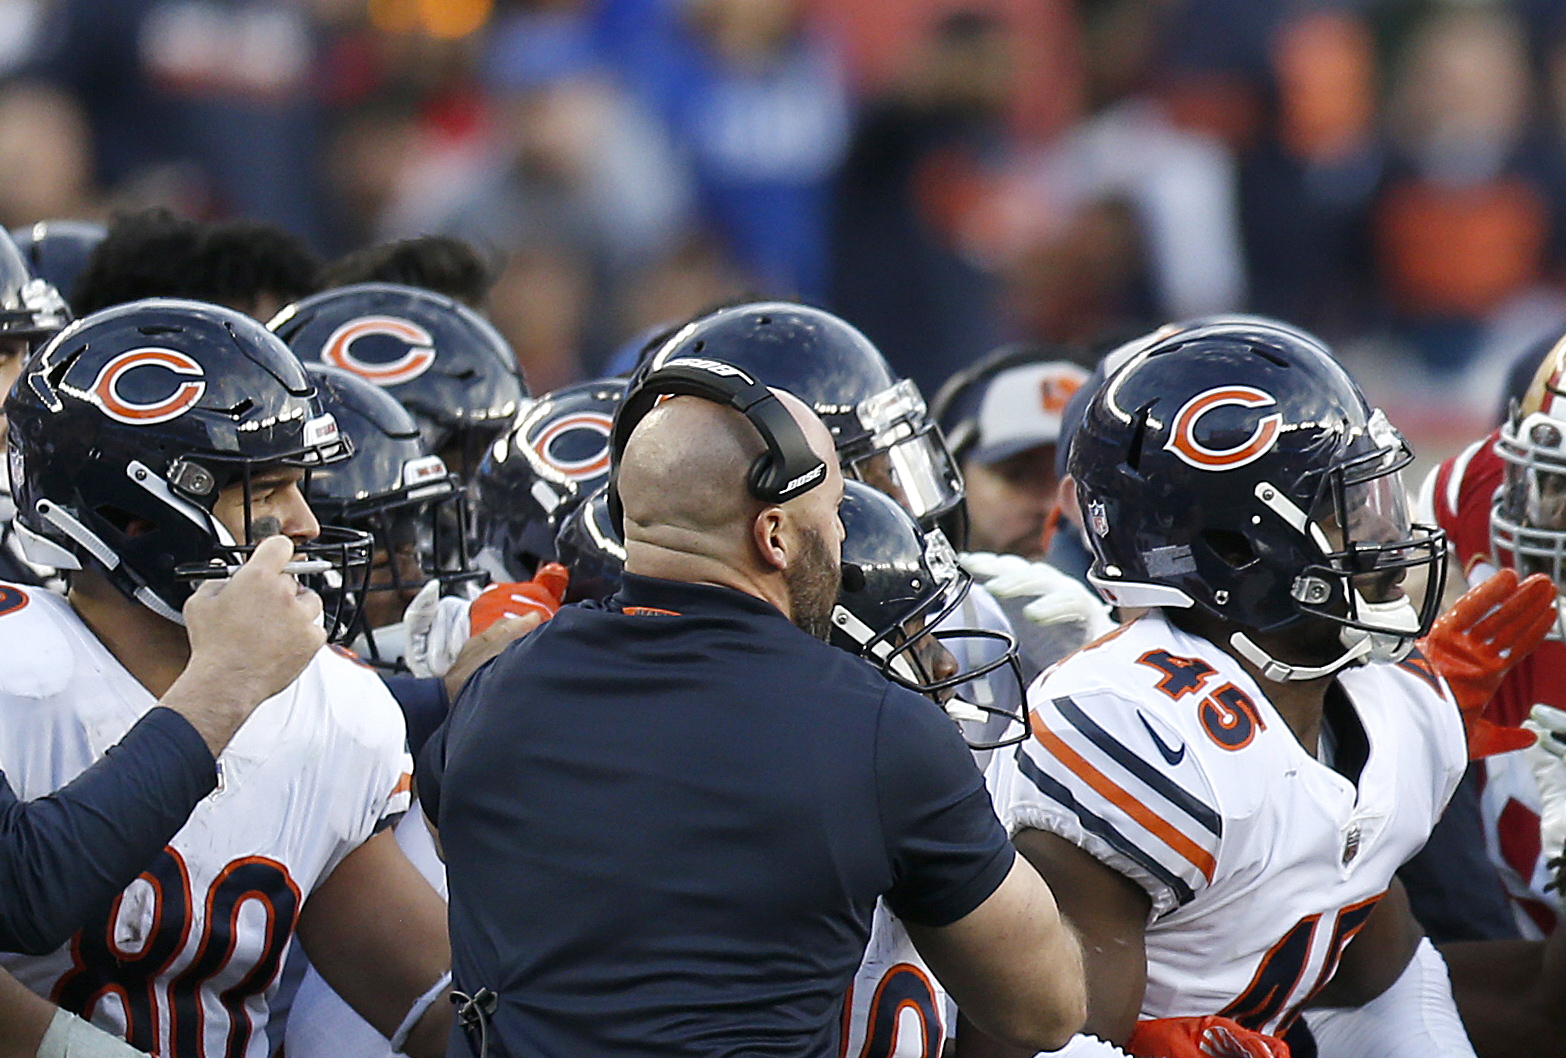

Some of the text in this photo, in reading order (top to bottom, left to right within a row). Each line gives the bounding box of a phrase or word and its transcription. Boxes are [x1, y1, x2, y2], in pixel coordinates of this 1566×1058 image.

[85, 347, 207, 425] C
[1162, 386, 1283, 472] C
[1135, 648, 1267, 752] 45
